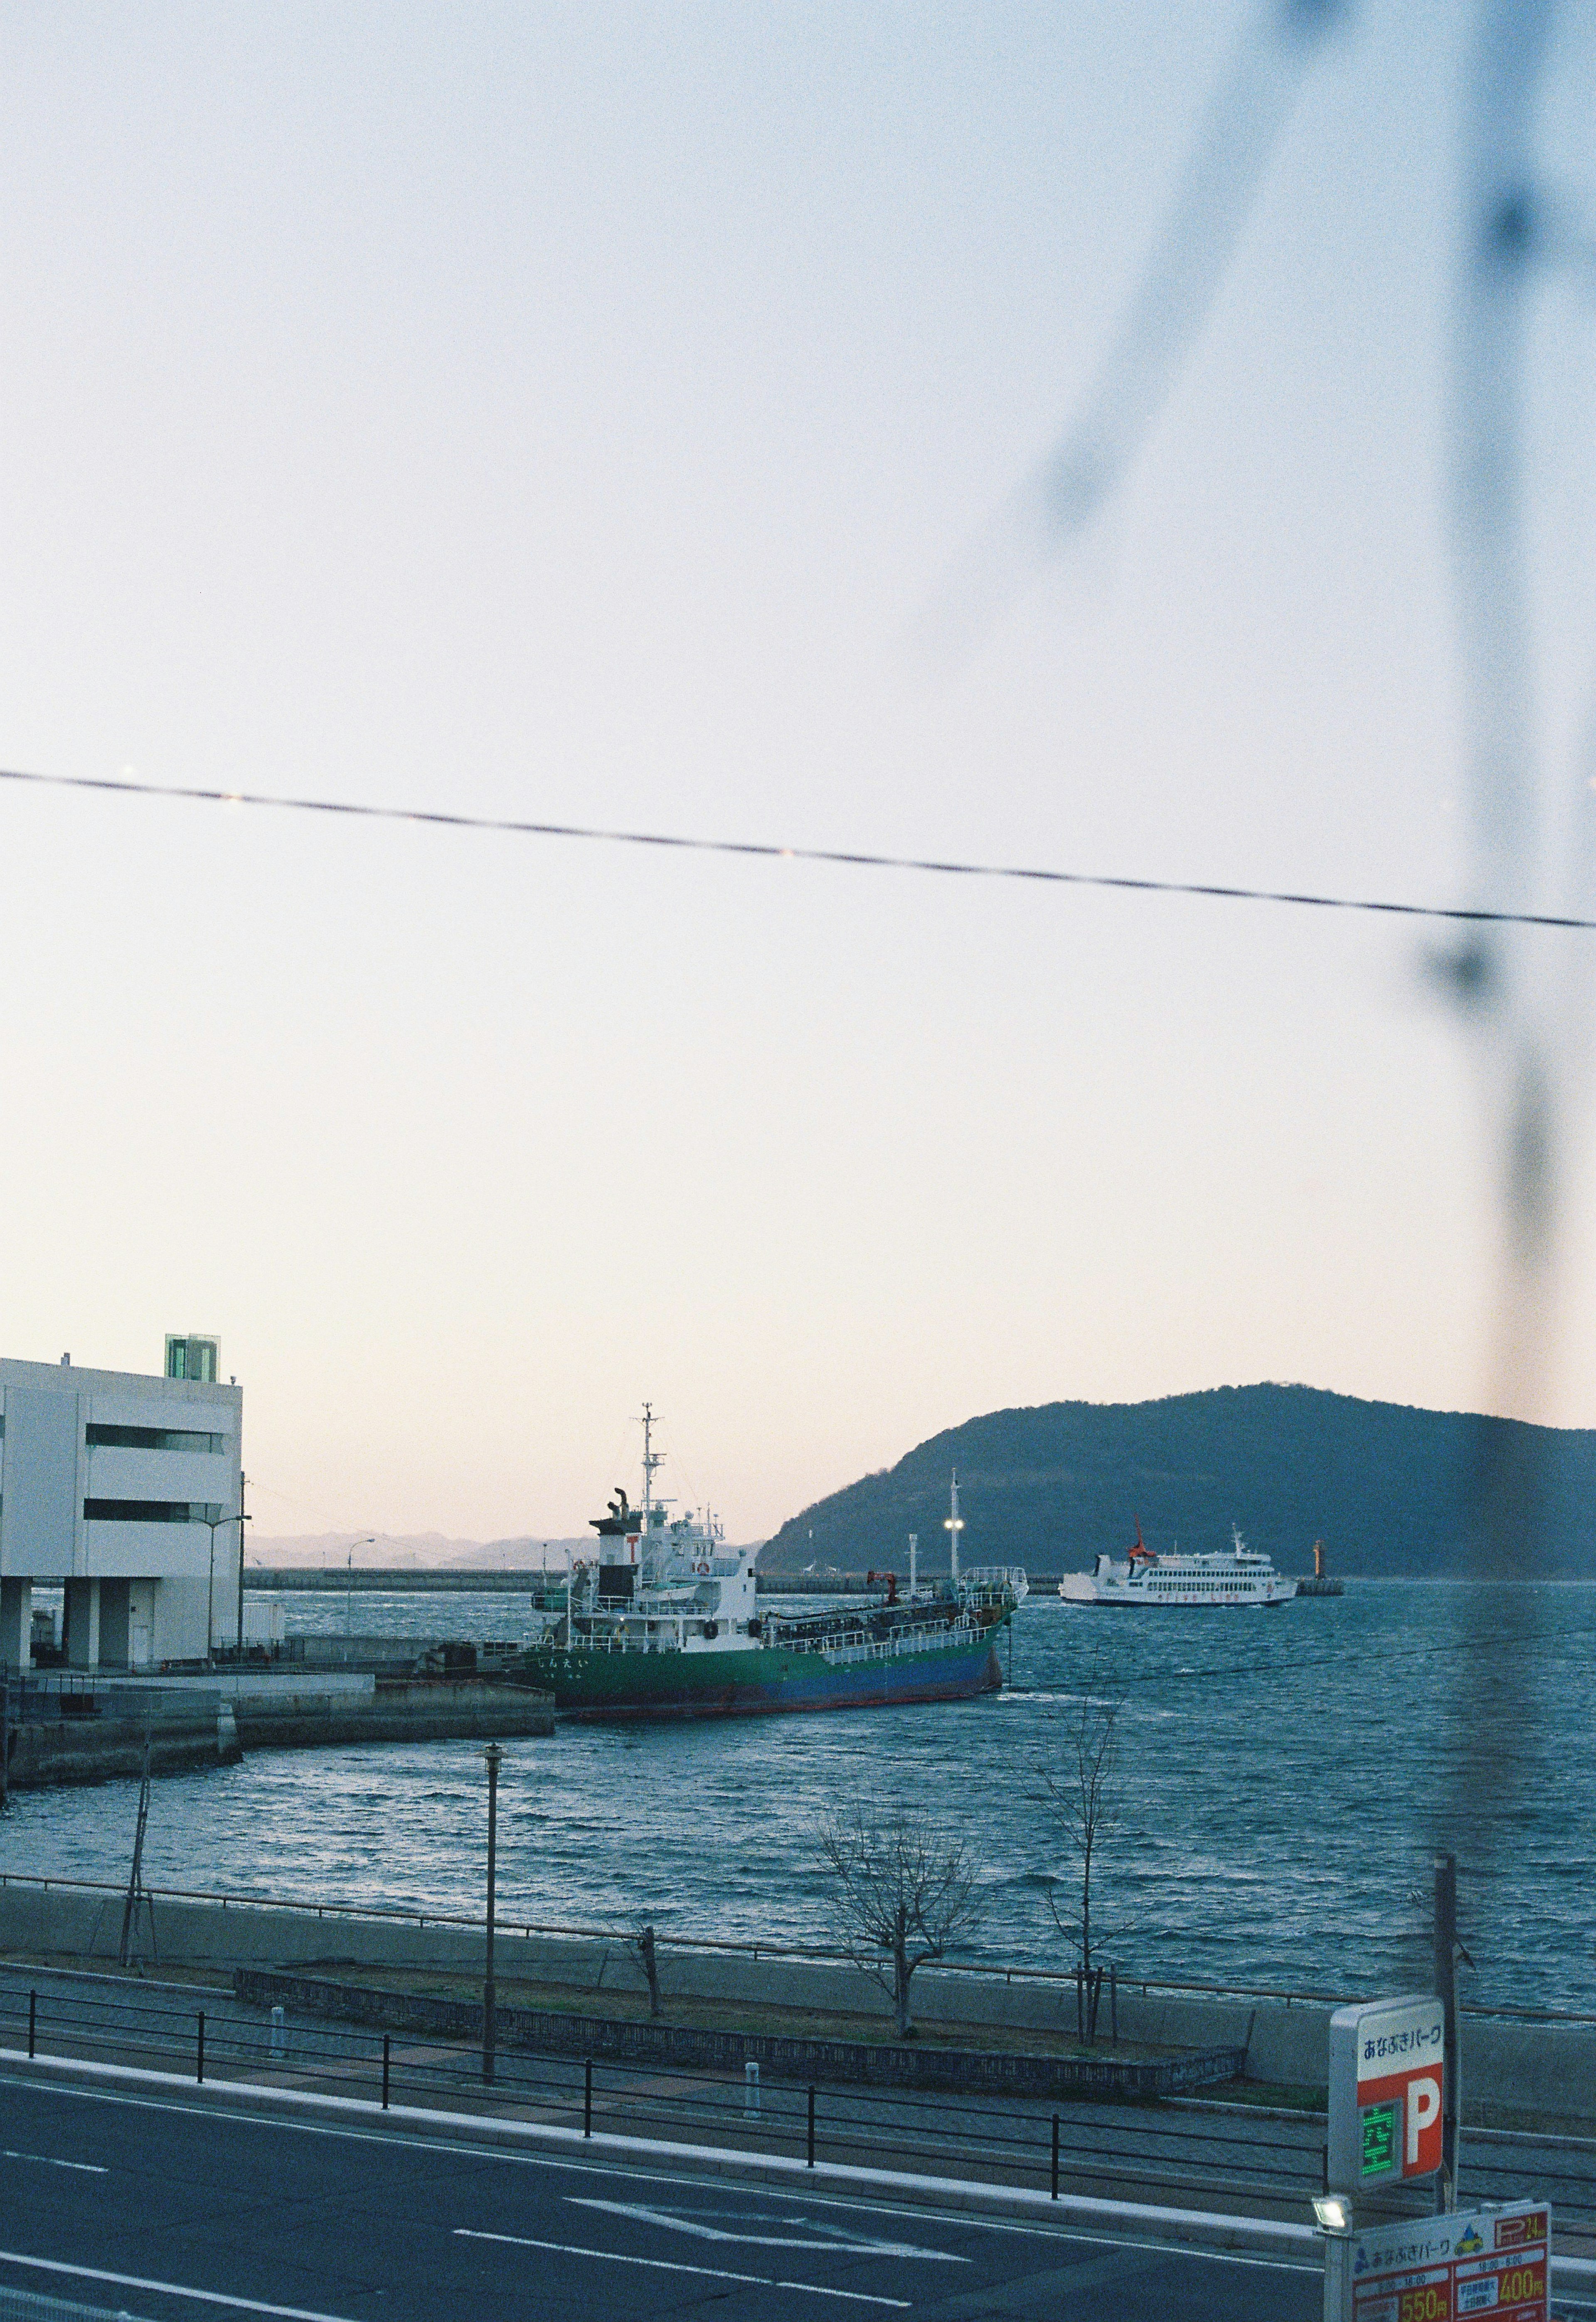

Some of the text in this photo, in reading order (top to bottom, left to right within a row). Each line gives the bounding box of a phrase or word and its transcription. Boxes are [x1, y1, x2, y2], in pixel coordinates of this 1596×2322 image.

[1364, 2025, 1441, 2059] あなぶきパーク
[1407, 2077, 1441, 2164] P
[1362, 2108, 1392, 2175] 空
[1372, 2240, 1450, 2268] あなぶきパーク
[1500, 2270, 1543, 2303] 400円
